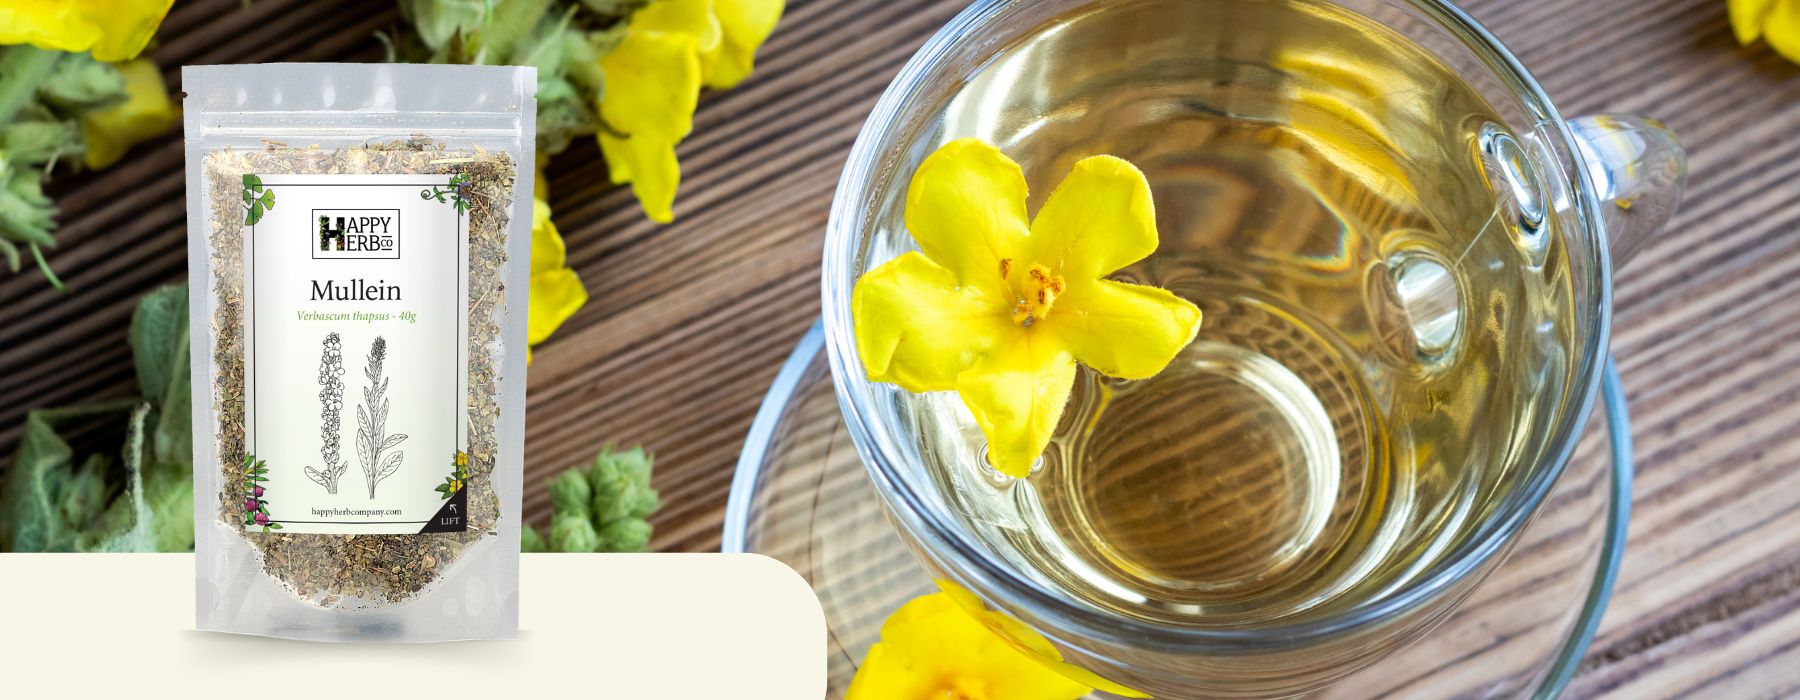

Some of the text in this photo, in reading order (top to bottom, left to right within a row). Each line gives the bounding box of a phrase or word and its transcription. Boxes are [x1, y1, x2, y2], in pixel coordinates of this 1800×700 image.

[319, 215, 391, 251] HAPPY
[310, 279, 402, 301] Mullein
[297, 310, 350, 321] Verbascum
[352, 310, 390, 324] thapsus
[398, 311, 417, 324] 40g
[311, 507, 402, 518] happyherbcompany.com
[441, 517, 460, 526] LIFT
